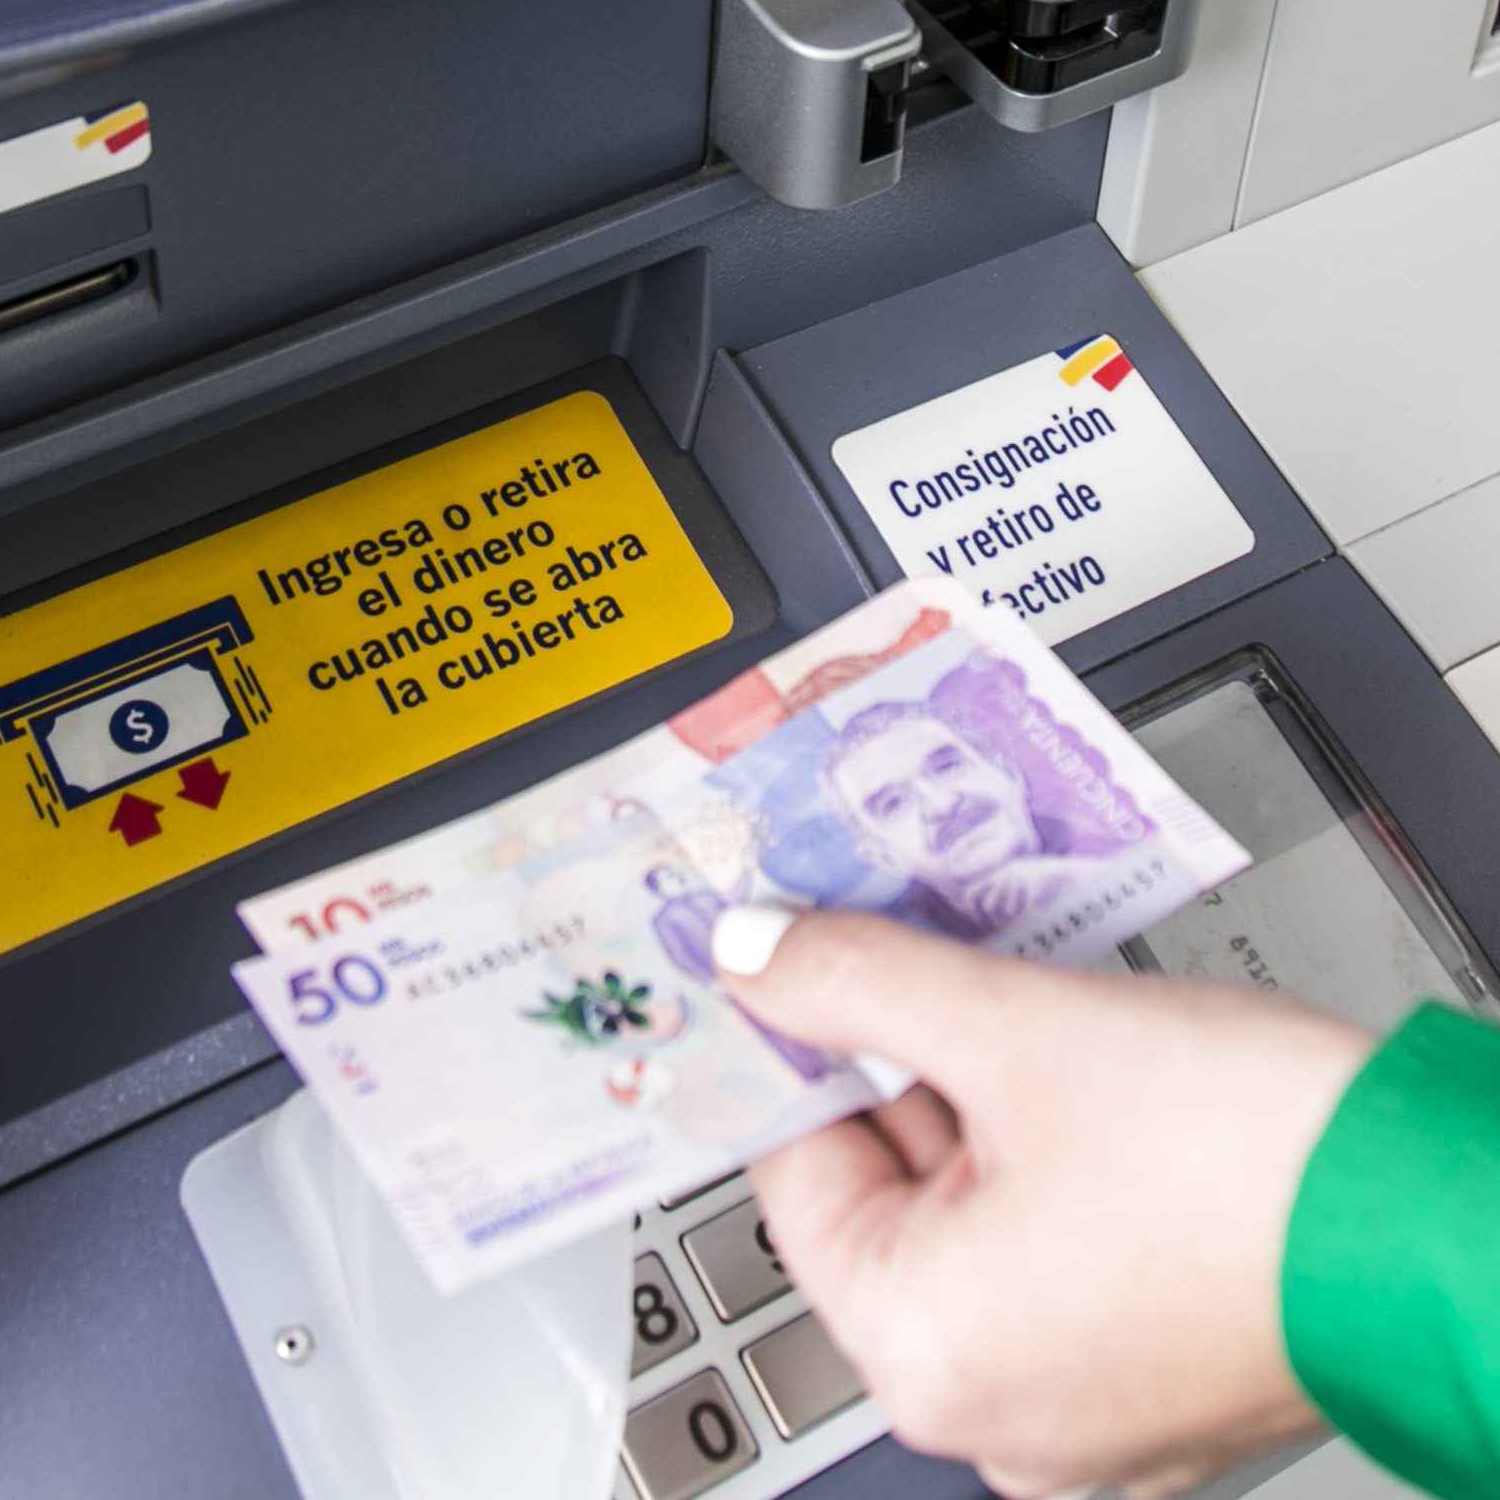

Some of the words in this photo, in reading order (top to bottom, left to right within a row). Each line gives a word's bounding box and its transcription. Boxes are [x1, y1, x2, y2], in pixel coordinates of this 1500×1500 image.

[888, 404, 1117, 519] Consignación
[256, 518, 436, 608] Ingresa
[441, 499, 473, 534] o
[478, 447, 603, 516] retira
[356, 573, 402, 619] el
[411, 516, 558, 597] dinero
[955, 503, 1056, 570] retiro
[1054, 481, 1103, 526] de
[305, 605, 473, 694] cuando
[481, 574, 537, 619] se
[545, 525, 650, 595] abra
[373, 671, 430, 718] la
[435, 589, 627, 692] cubierta
[287, 954, 387, 1027] 50
[633, 1283, 679, 1347] 8
[688, 1400, 739, 1466] 0
